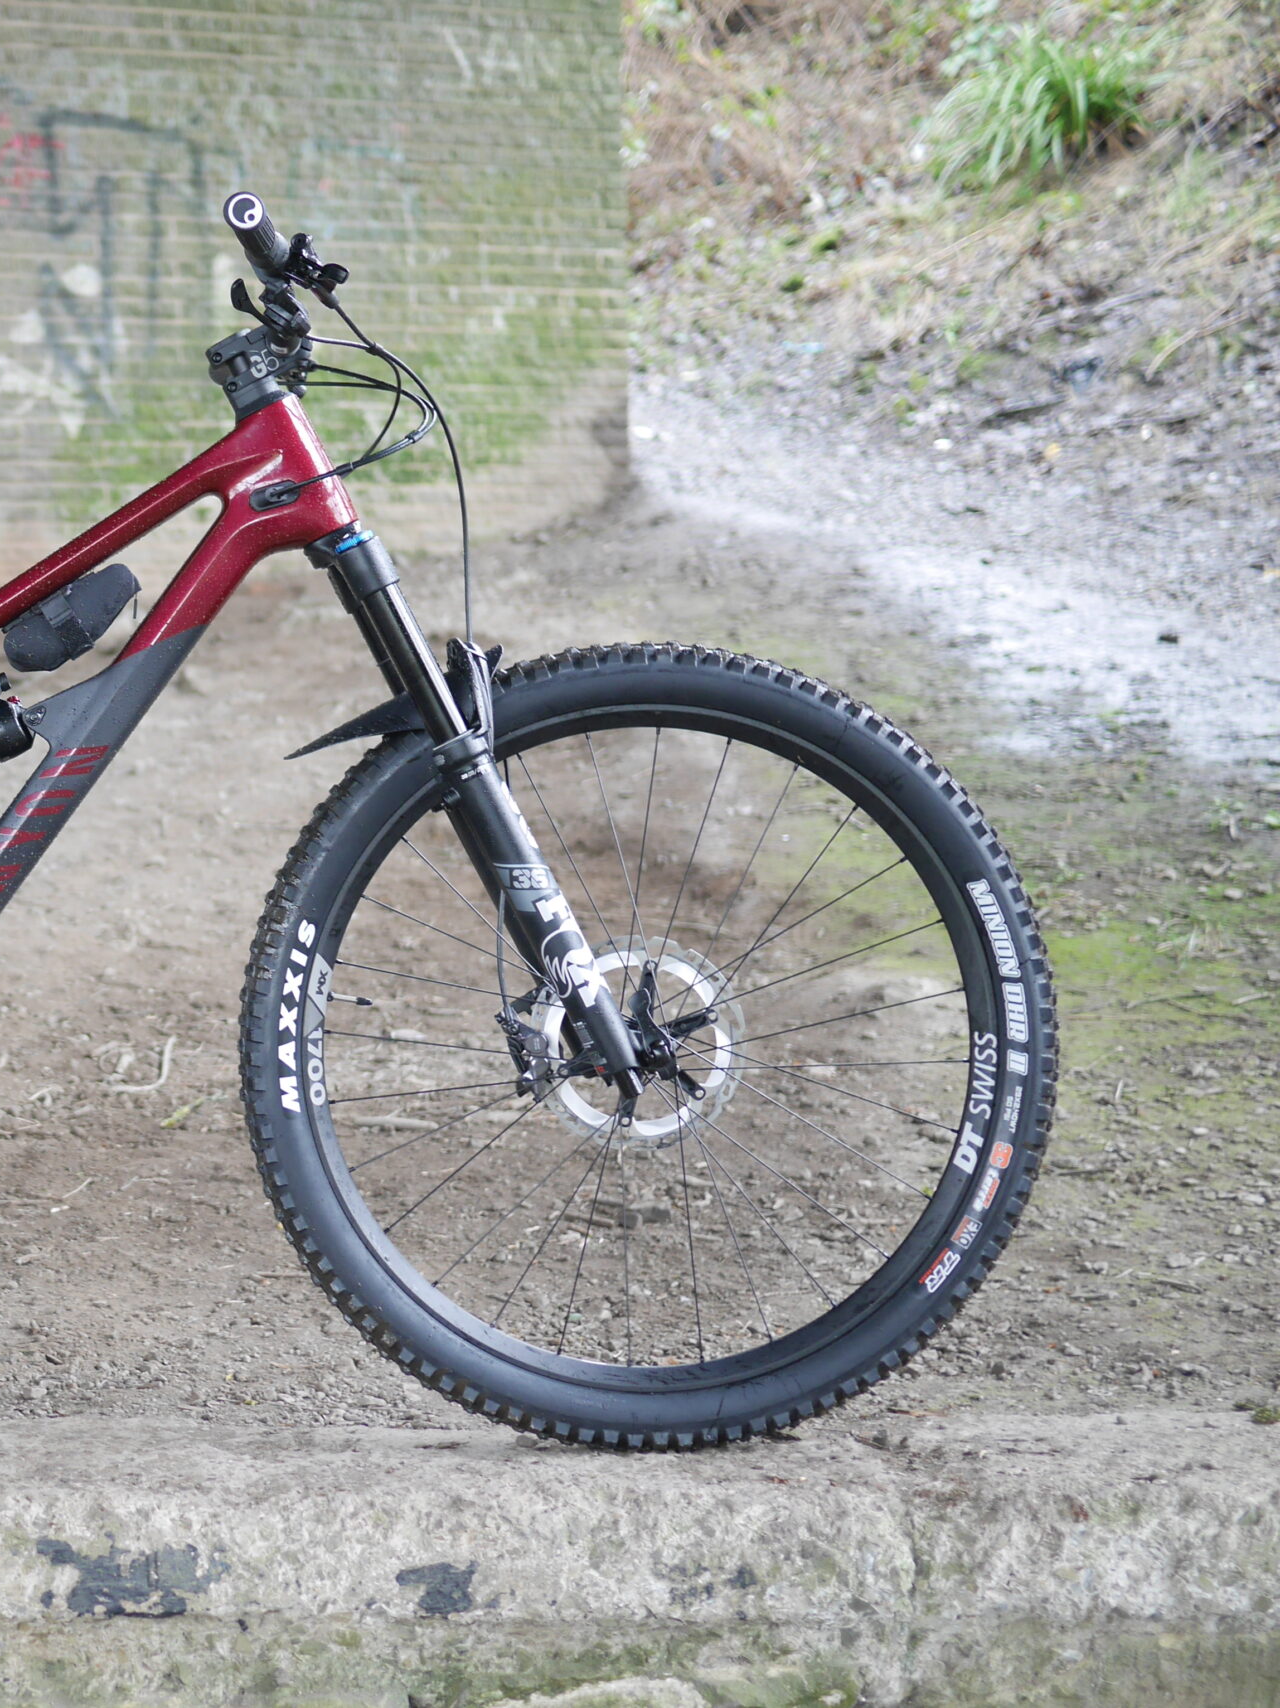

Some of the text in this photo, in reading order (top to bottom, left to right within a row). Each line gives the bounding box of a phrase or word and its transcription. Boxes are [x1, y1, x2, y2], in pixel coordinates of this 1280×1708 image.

[249, 349, 280, 379] G5
[512, 868, 549, 889] 36
[535, 892, 612, 1009] FOX
[966, 878, 1022, 977] MINION
[1002, 982, 1029, 1043] DHR
[278, 919, 317, 1113] MAXXIS
[952, 1031, 998, 1175] DT SWISS
[924, 1250, 962, 1293] TR
[958, 1220, 981, 1248] EXO
